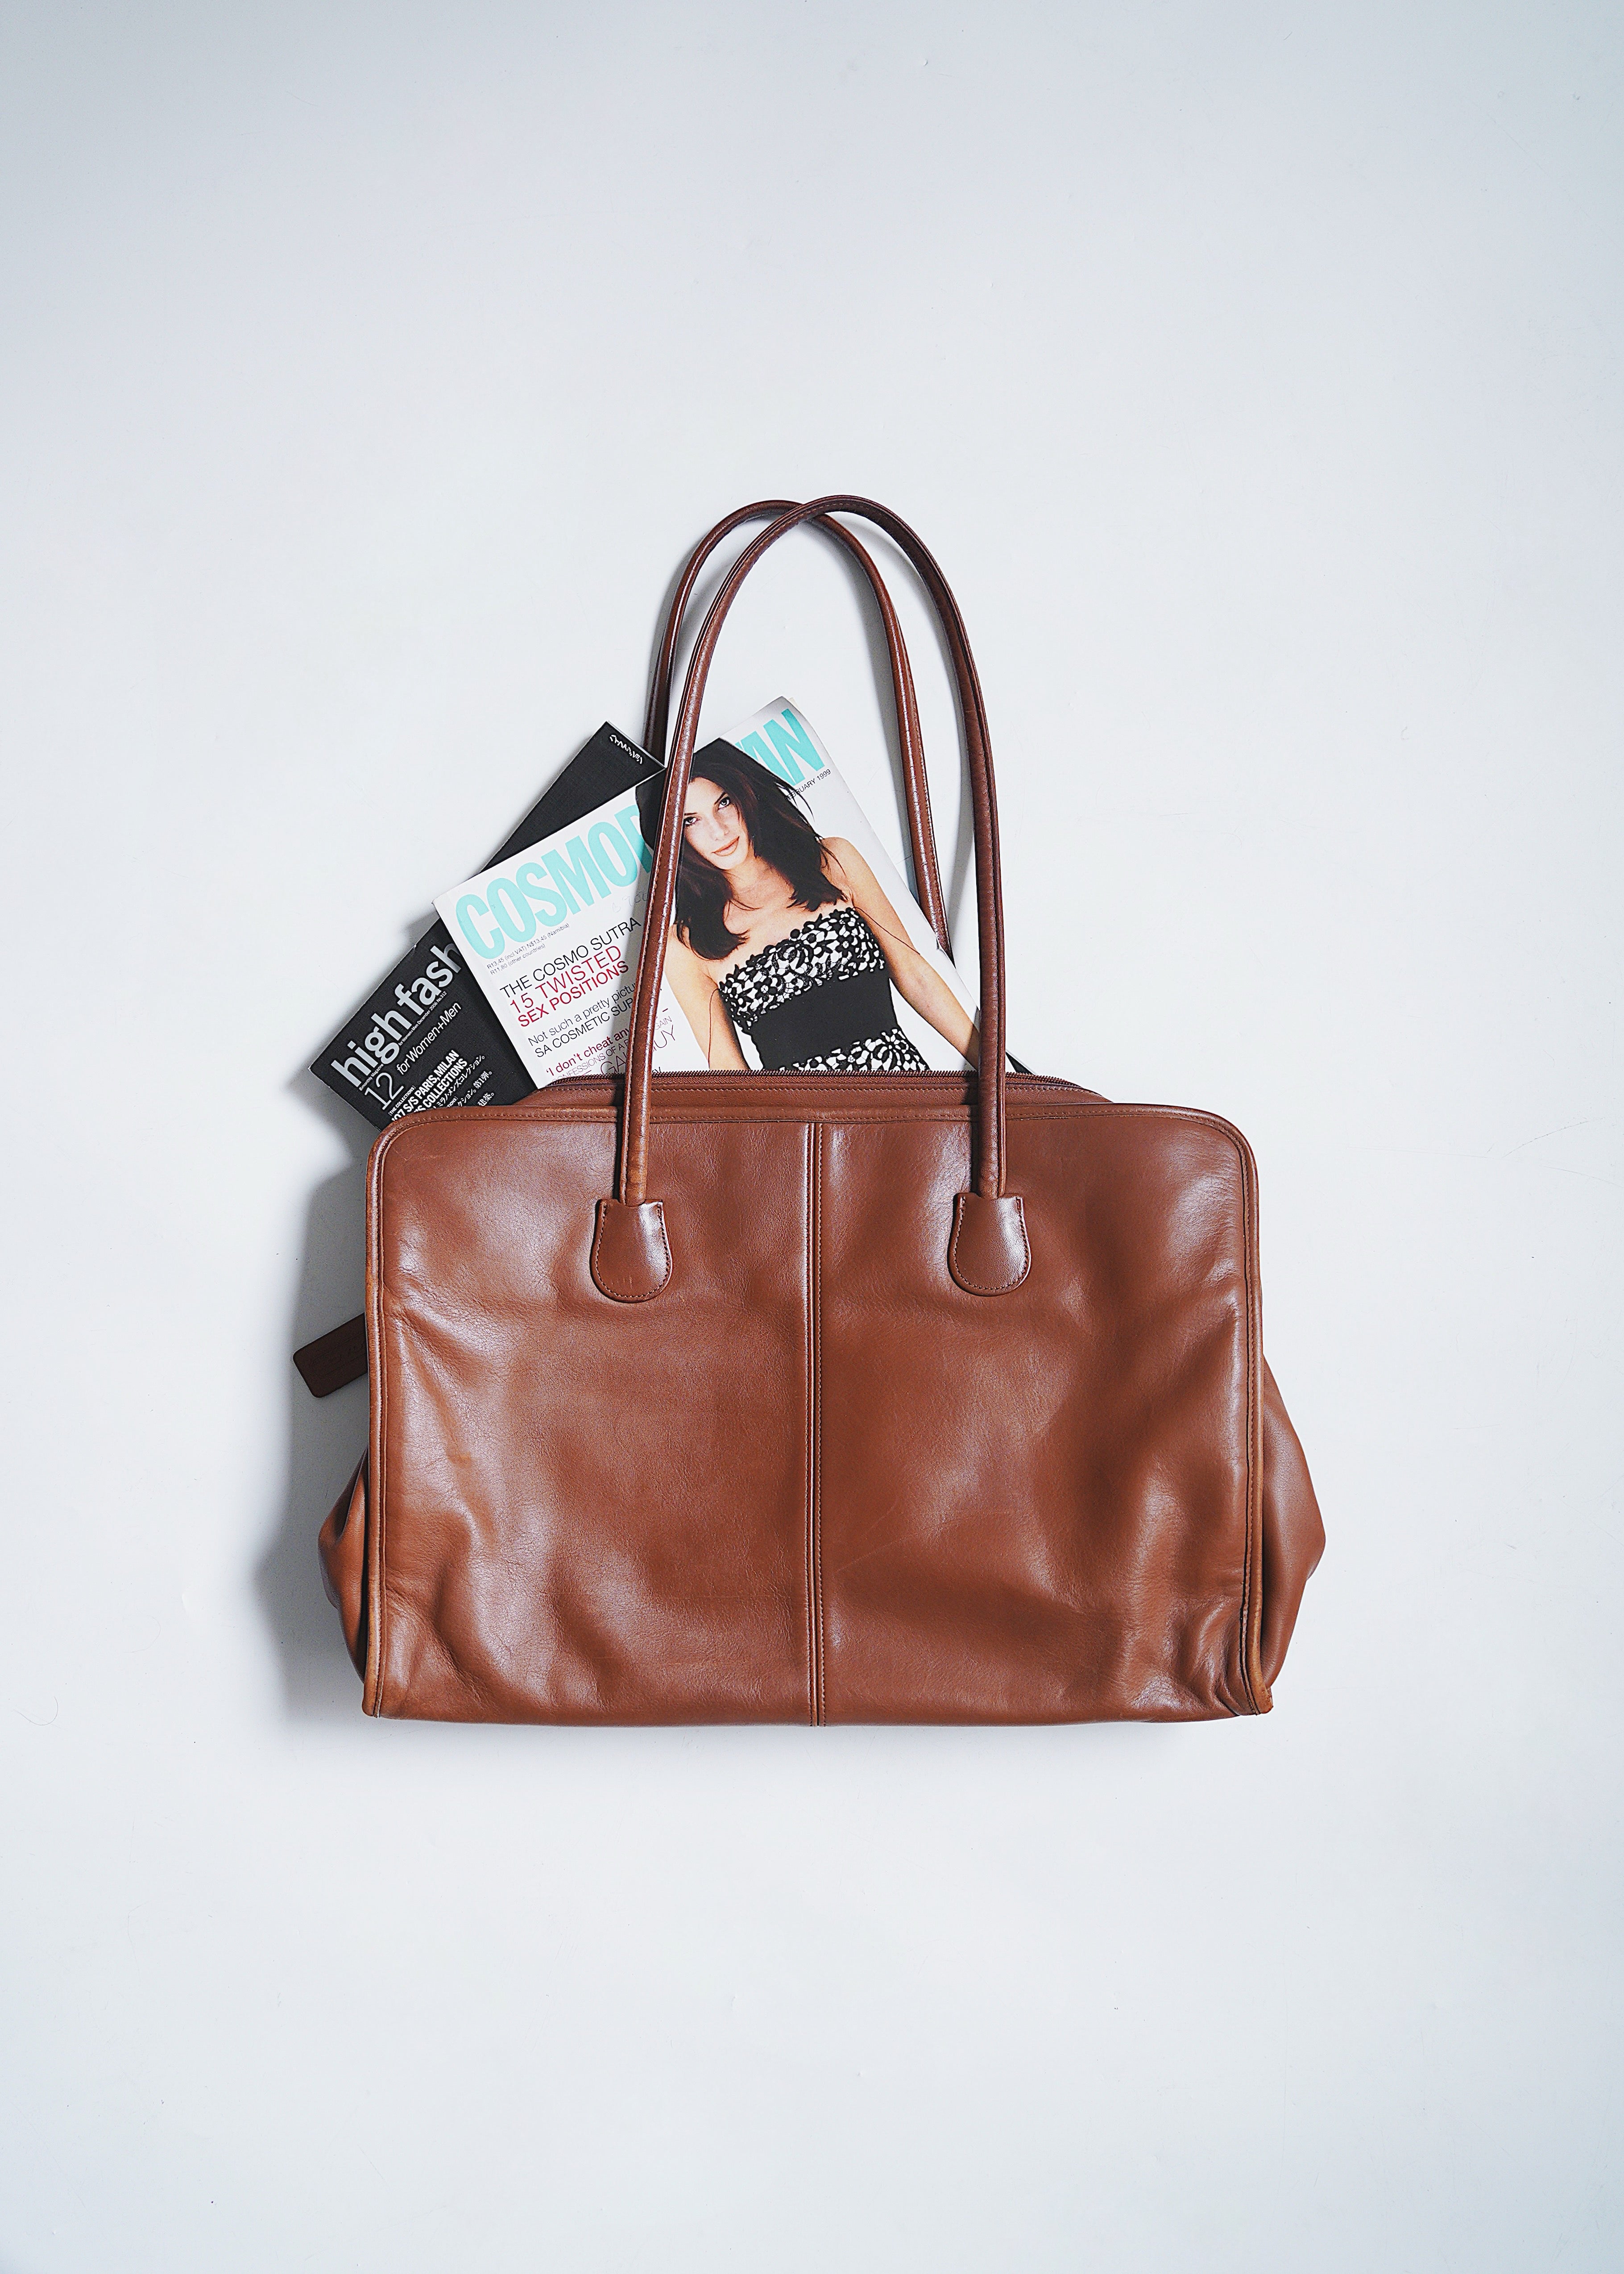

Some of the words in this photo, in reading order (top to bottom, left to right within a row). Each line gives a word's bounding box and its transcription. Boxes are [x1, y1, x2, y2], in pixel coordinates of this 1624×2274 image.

[787, 778, 815, 800] EBRUARY
[817, 769, 831, 780] 1999
[486, 957, 504, 969] R13,45
[505, 951, 515, 961] (incl
[514, 946, 527, 954] VAT)
[526, 935, 547, 948] N$13,45
[547, 923, 569, 938] (Namibia)
[490, 963, 507, 975] R11,80
[508, 956, 522, 966] (other
[522, 943, 546, 958] countries)
[499, 975, 532, 998] THE
[533, 945, 588, 981] COSMO
[591, 917, 642, 950] SUTRA
[510, 992, 533, 1013] 15
[535, 945, 621, 998] TWISTED
[518, 1004, 549, 1027] SEX
[550, 960, 629, 1010] POSITIONS
[370, 1063, 384, 1077] Magazine
[417, 1010, 431, 1025] December
[429, 1001, 438, 1011] 2006
[396, 1058, 411, 1075] for
[406, 1003, 461, 1062] Women+Men
[527, 1031, 548, 1046] Not
[549, 1018, 574, 1036] such
[574, 1014, 583, 1022] a
[582, 998, 610, 1020] pretty
[534, 1044, 552, 1058] SA
[552, 1011, 610, 1048] COSMETIC
[653, 1025, 675, 1051] UY
[331, 1011, 412, 1087] high
[556, 1053, 583, 1073] don't
[584, 1037, 613, 1057] cheat
[605, 1045, 617, 1057] OF
[617, 1042, 626, 1051] A
[365, 1072, 404, 1110] 12
[403, 1096, 418, 1112] S/S
[423, 1058, 467, 1108] COLLECTIONS
